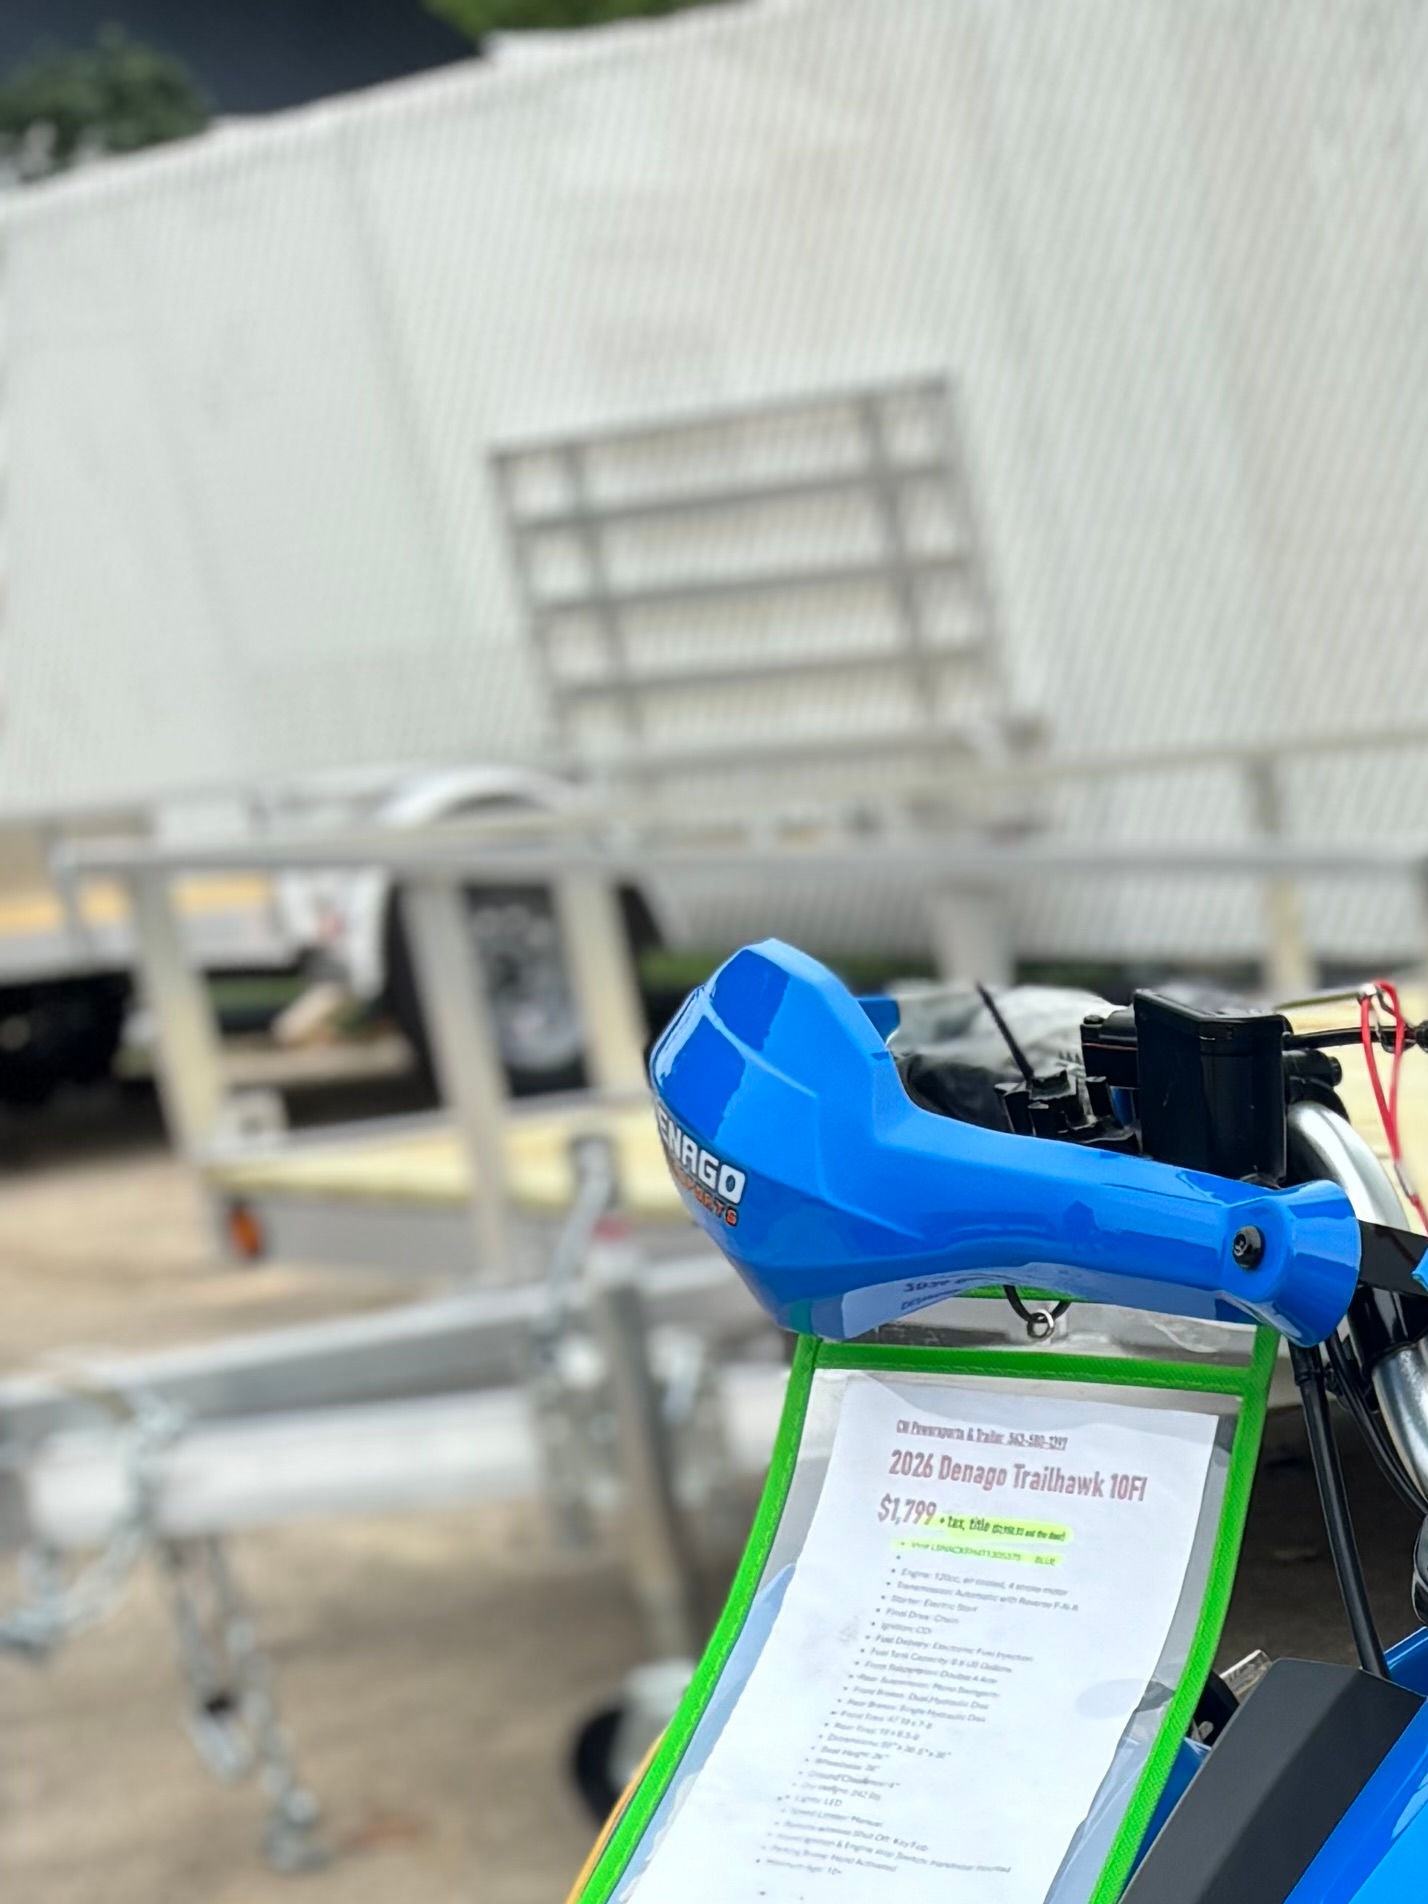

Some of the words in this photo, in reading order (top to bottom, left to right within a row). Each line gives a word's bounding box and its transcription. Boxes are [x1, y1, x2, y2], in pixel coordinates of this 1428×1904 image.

[655, 1102, 747, 1206] ENAGO
[889, 1449, 934, 1479] 2026
[938, 1454, 1008, 1491] Denago
[1013, 1463, 1105, 1498] Trailhawk
[1109, 1473, 1148, 1501] 10FI
[877, 1493, 937, 1526] $1,799
[969, 1516, 990, 1532] title
